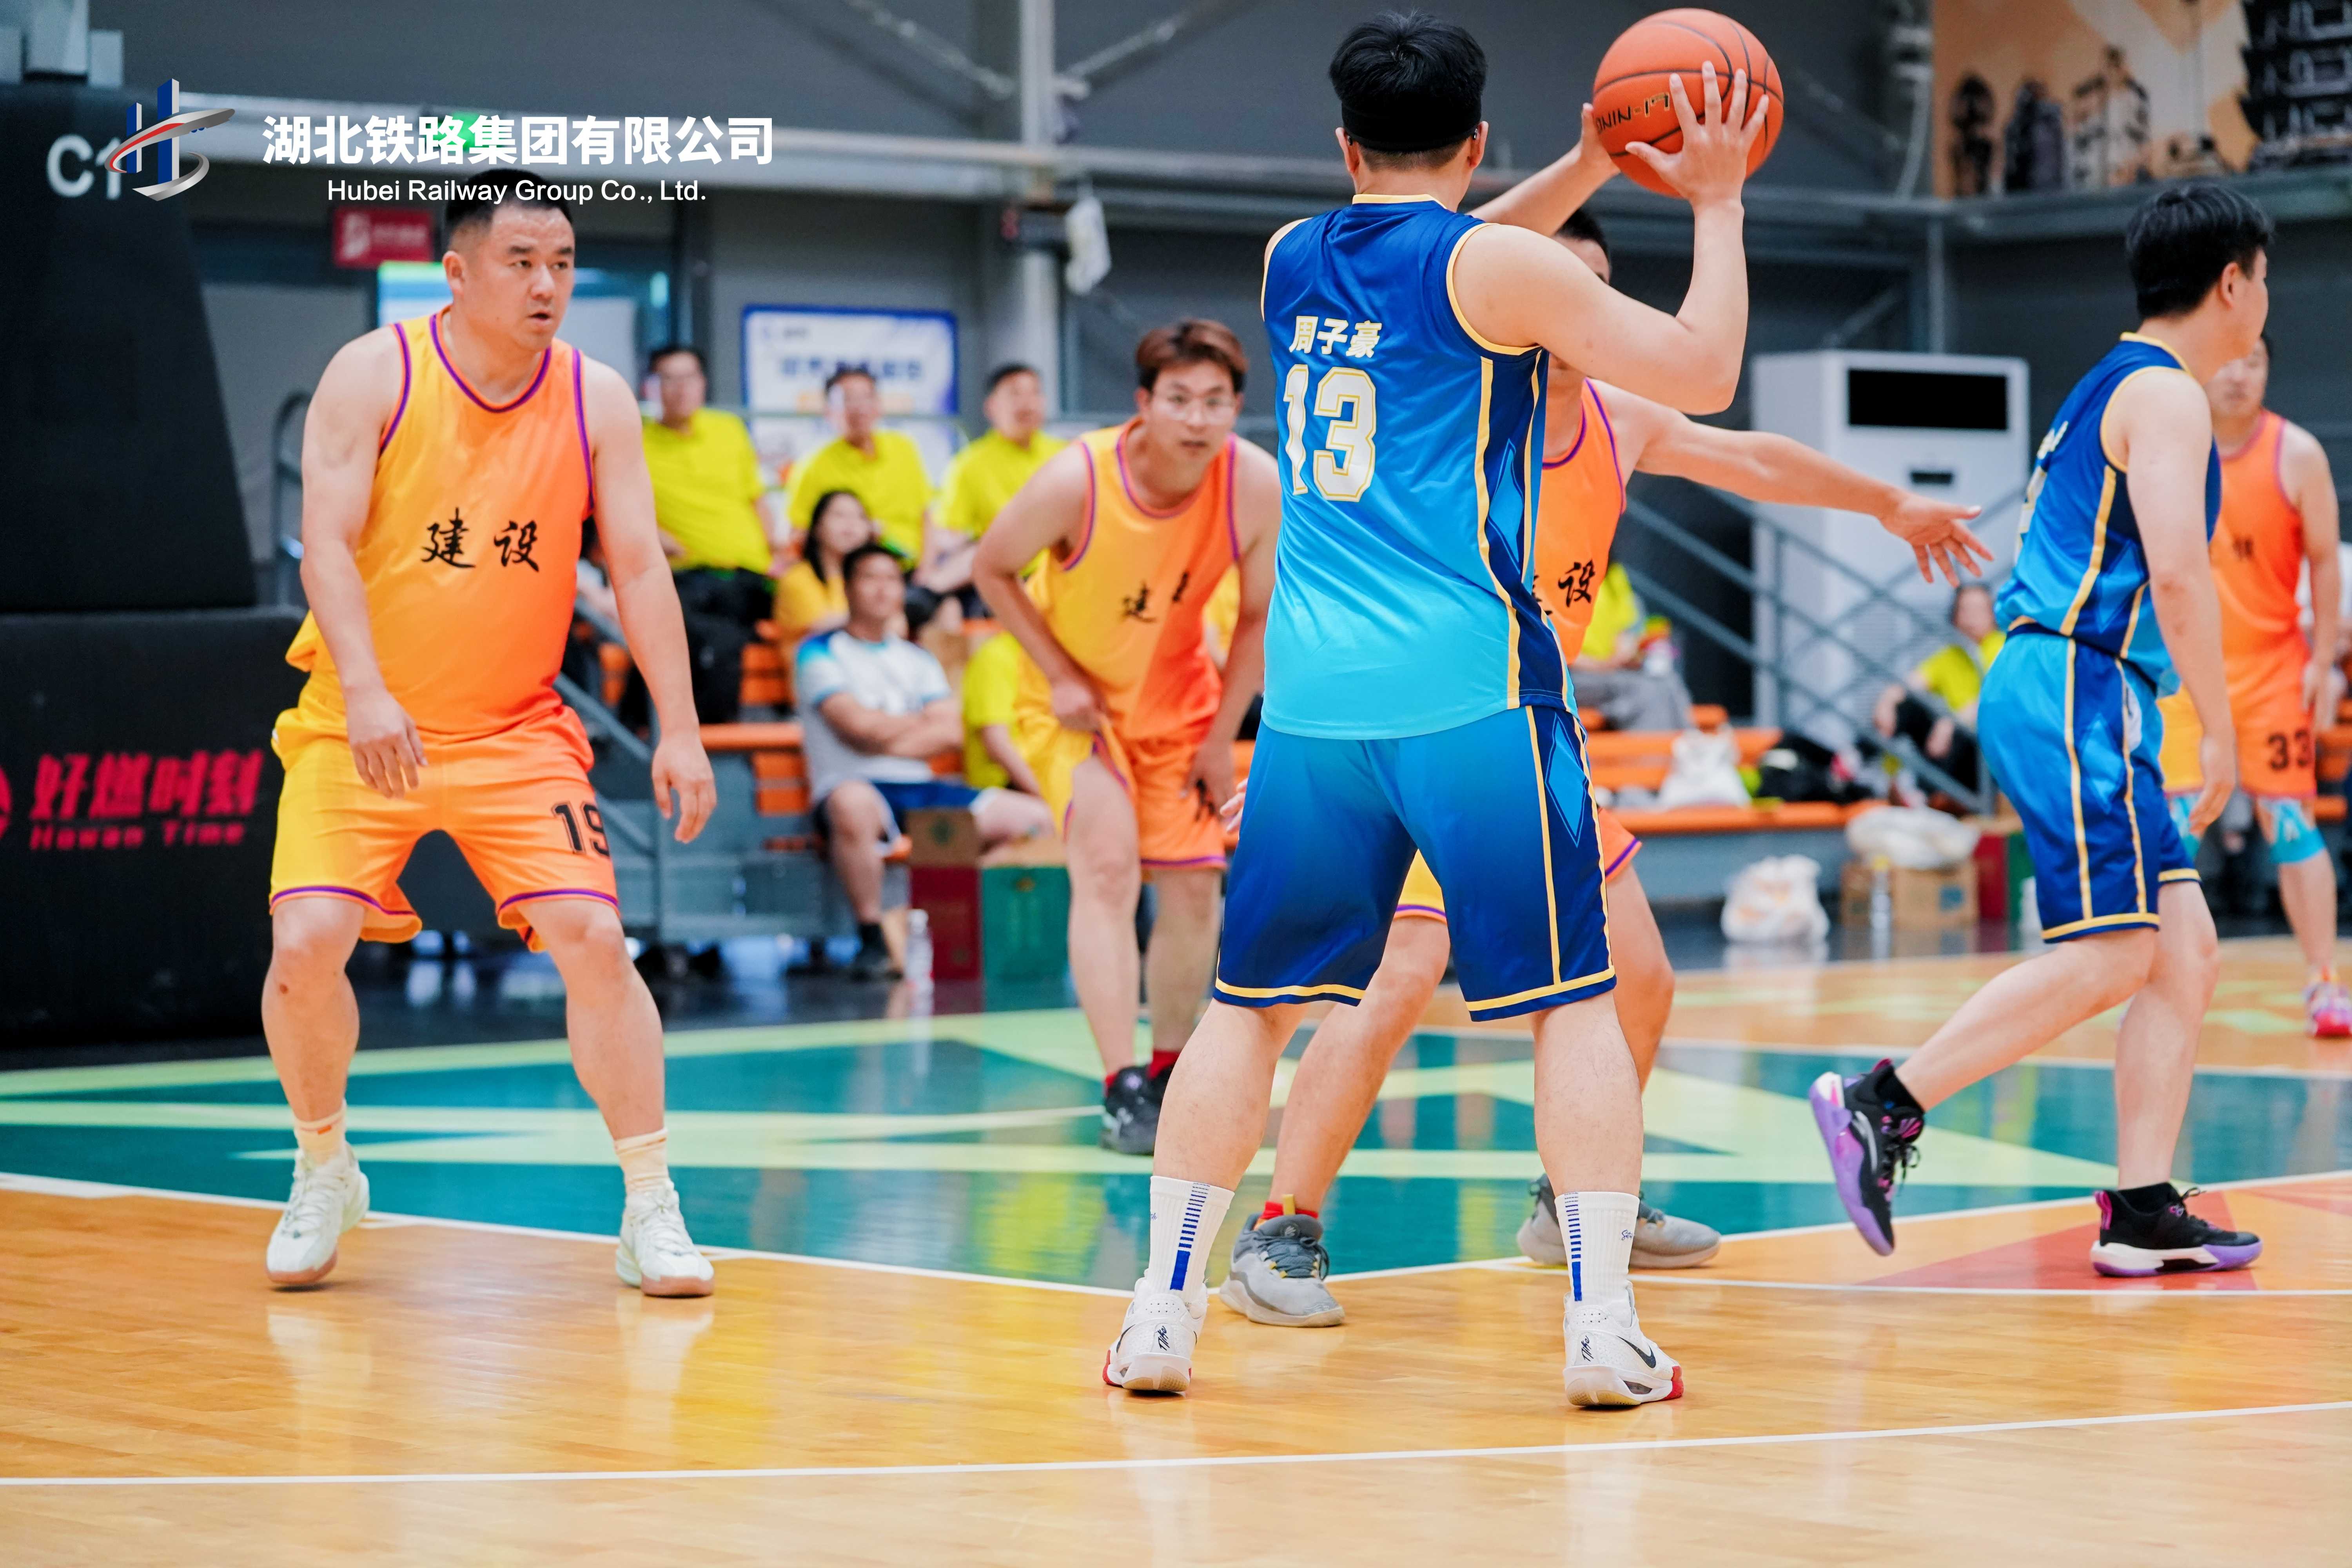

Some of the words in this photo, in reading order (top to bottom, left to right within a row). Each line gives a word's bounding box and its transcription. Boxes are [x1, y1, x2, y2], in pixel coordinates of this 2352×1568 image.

[46, 134, 122, 200] C1
[1289, 315, 1382, 358] 周子豪
[1283, 364, 1376, 503] 13
[421, 507, 539, 572] 建设
[1531, 558, 1595, 615] 设
[551, 800, 610, 858] 19
